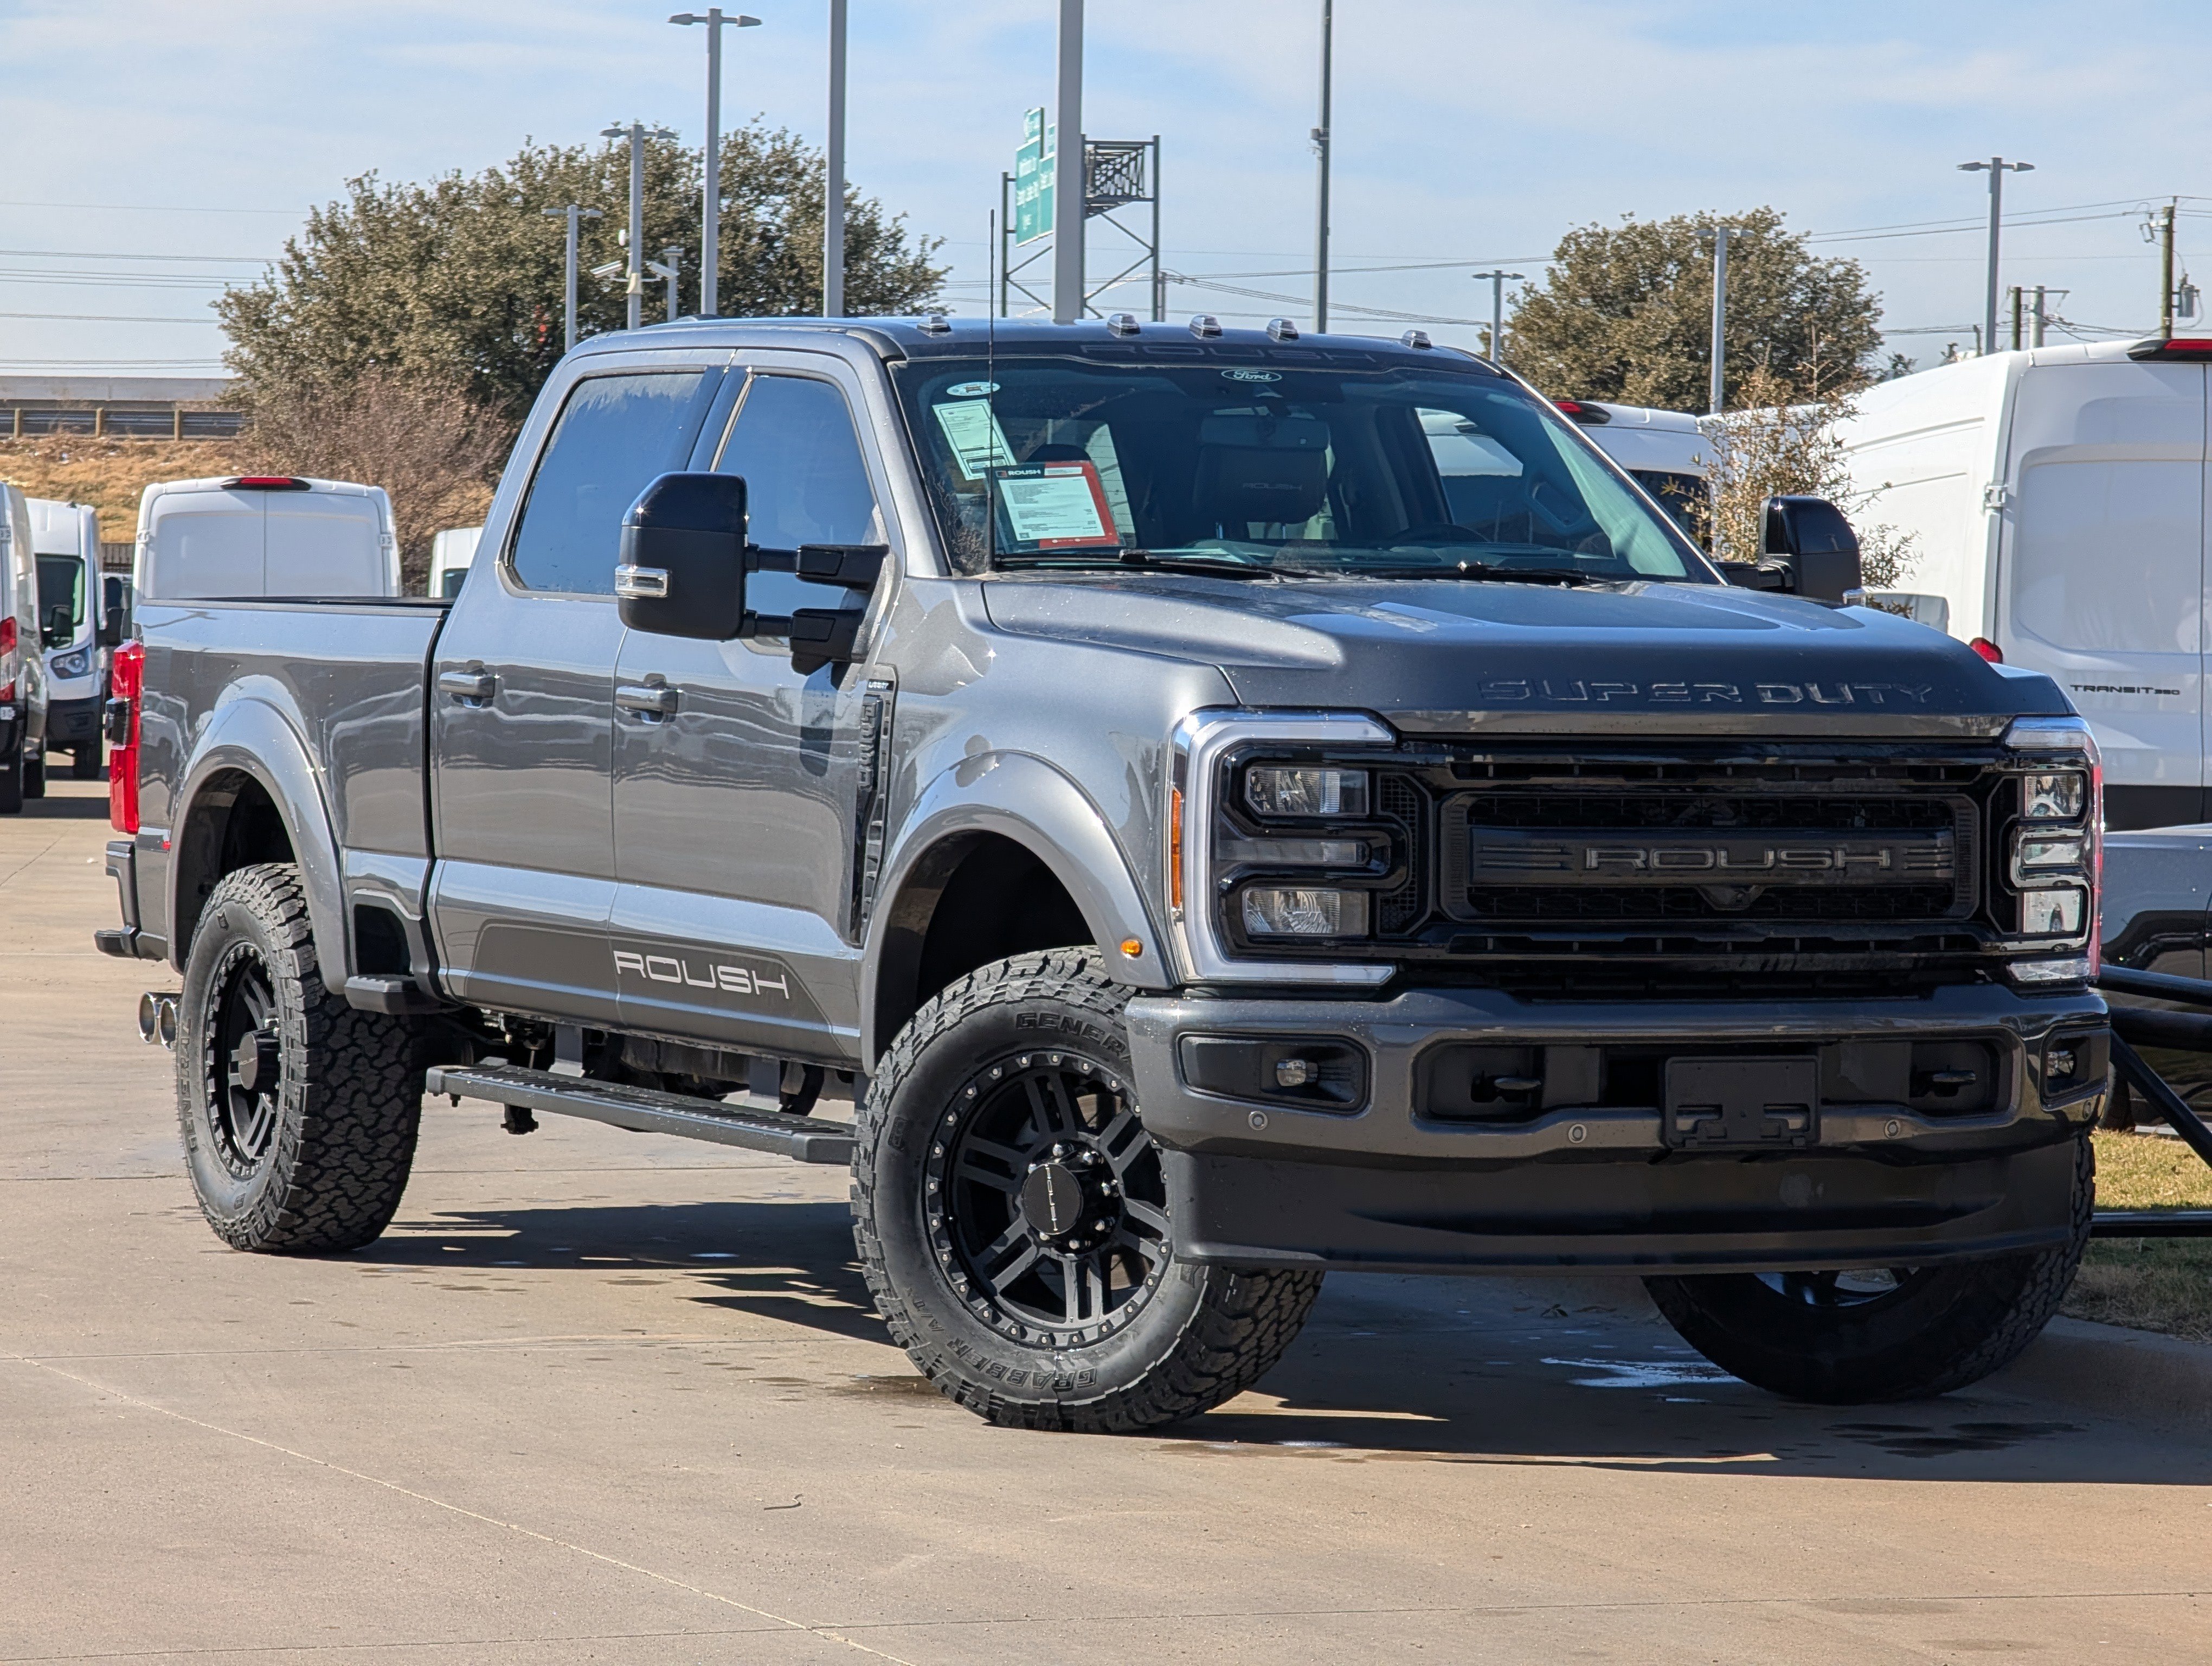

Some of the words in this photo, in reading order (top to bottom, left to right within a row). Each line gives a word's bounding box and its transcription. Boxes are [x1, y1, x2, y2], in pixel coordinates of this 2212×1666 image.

[1080, 344, 1377, 363] ROUSH
[1233, 370, 1272, 381] Ford
[1480, 680, 1744, 703] SUPER
[1755, 681, 1933, 704] DUTY
[2070, 684, 2153, 694] TRANSIT
[1585, 847, 1891, 872] ROUSH
[613, 951, 789, 999] ROUSH
[1015, 1011, 1131, 1062] GENER
[946, 1337, 1097, 1391] GRABBER
